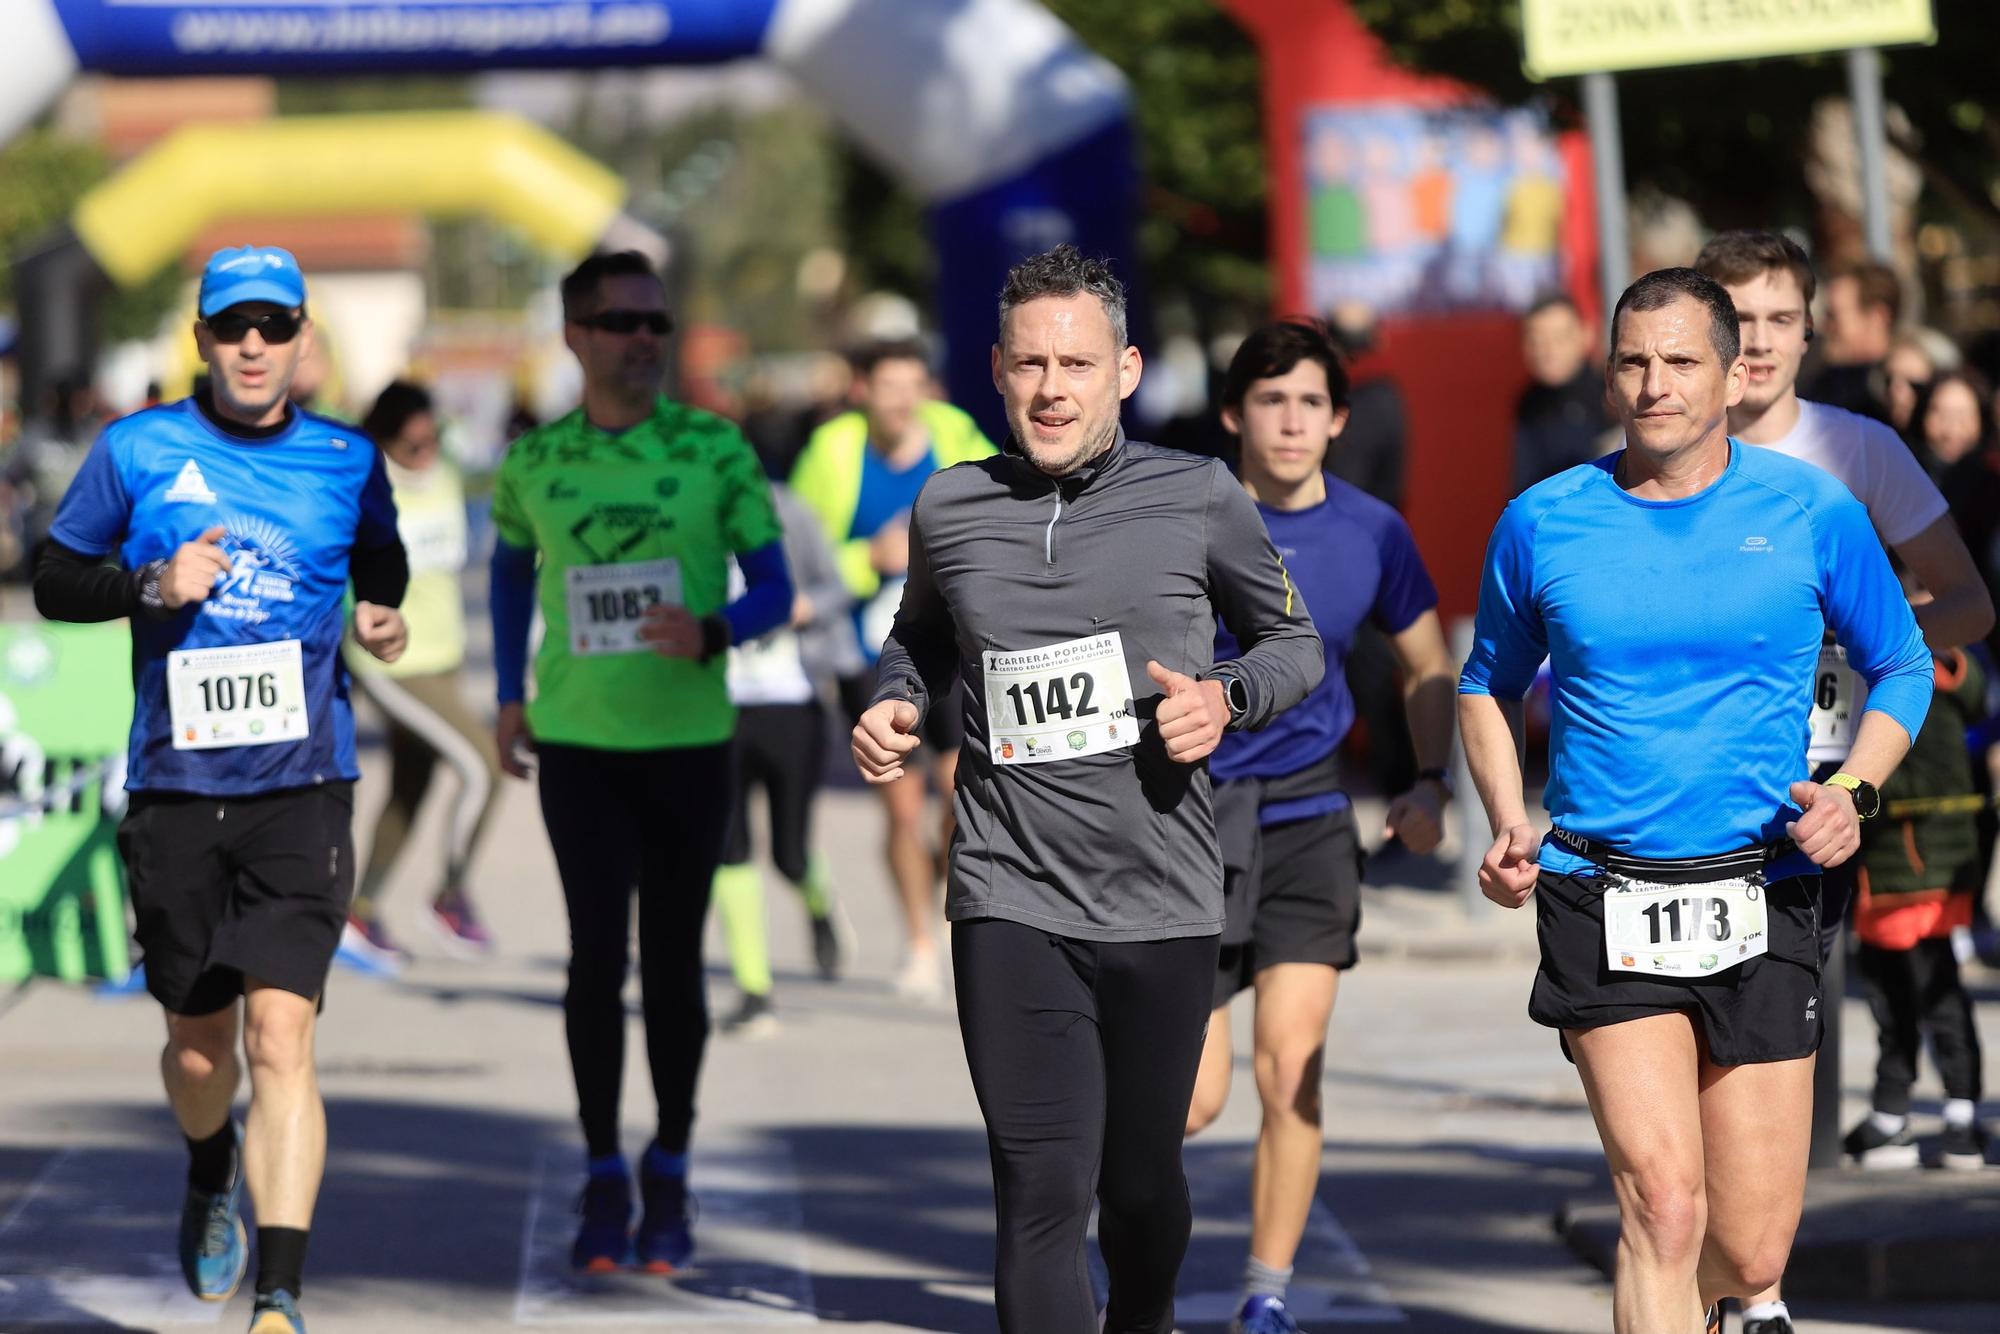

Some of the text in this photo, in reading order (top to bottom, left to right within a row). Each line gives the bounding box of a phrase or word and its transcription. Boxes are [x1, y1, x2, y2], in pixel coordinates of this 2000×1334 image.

[998, 653, 1051, 666] CARRERA
[1055, 639, 1112, 658] POPULAR
[1026, 658, 1069, 671] EDUCATIVO
[1086, 648, 1114, 659] OLIVOS
[198, 672, 278, 712] 1076
[1006, 672, 1099, 726] 1142
[1109, 707, 1130, 720] 10K
[1642, 897, 1731, 944] 1173
[1743, 930, 1762, 942] 10K
